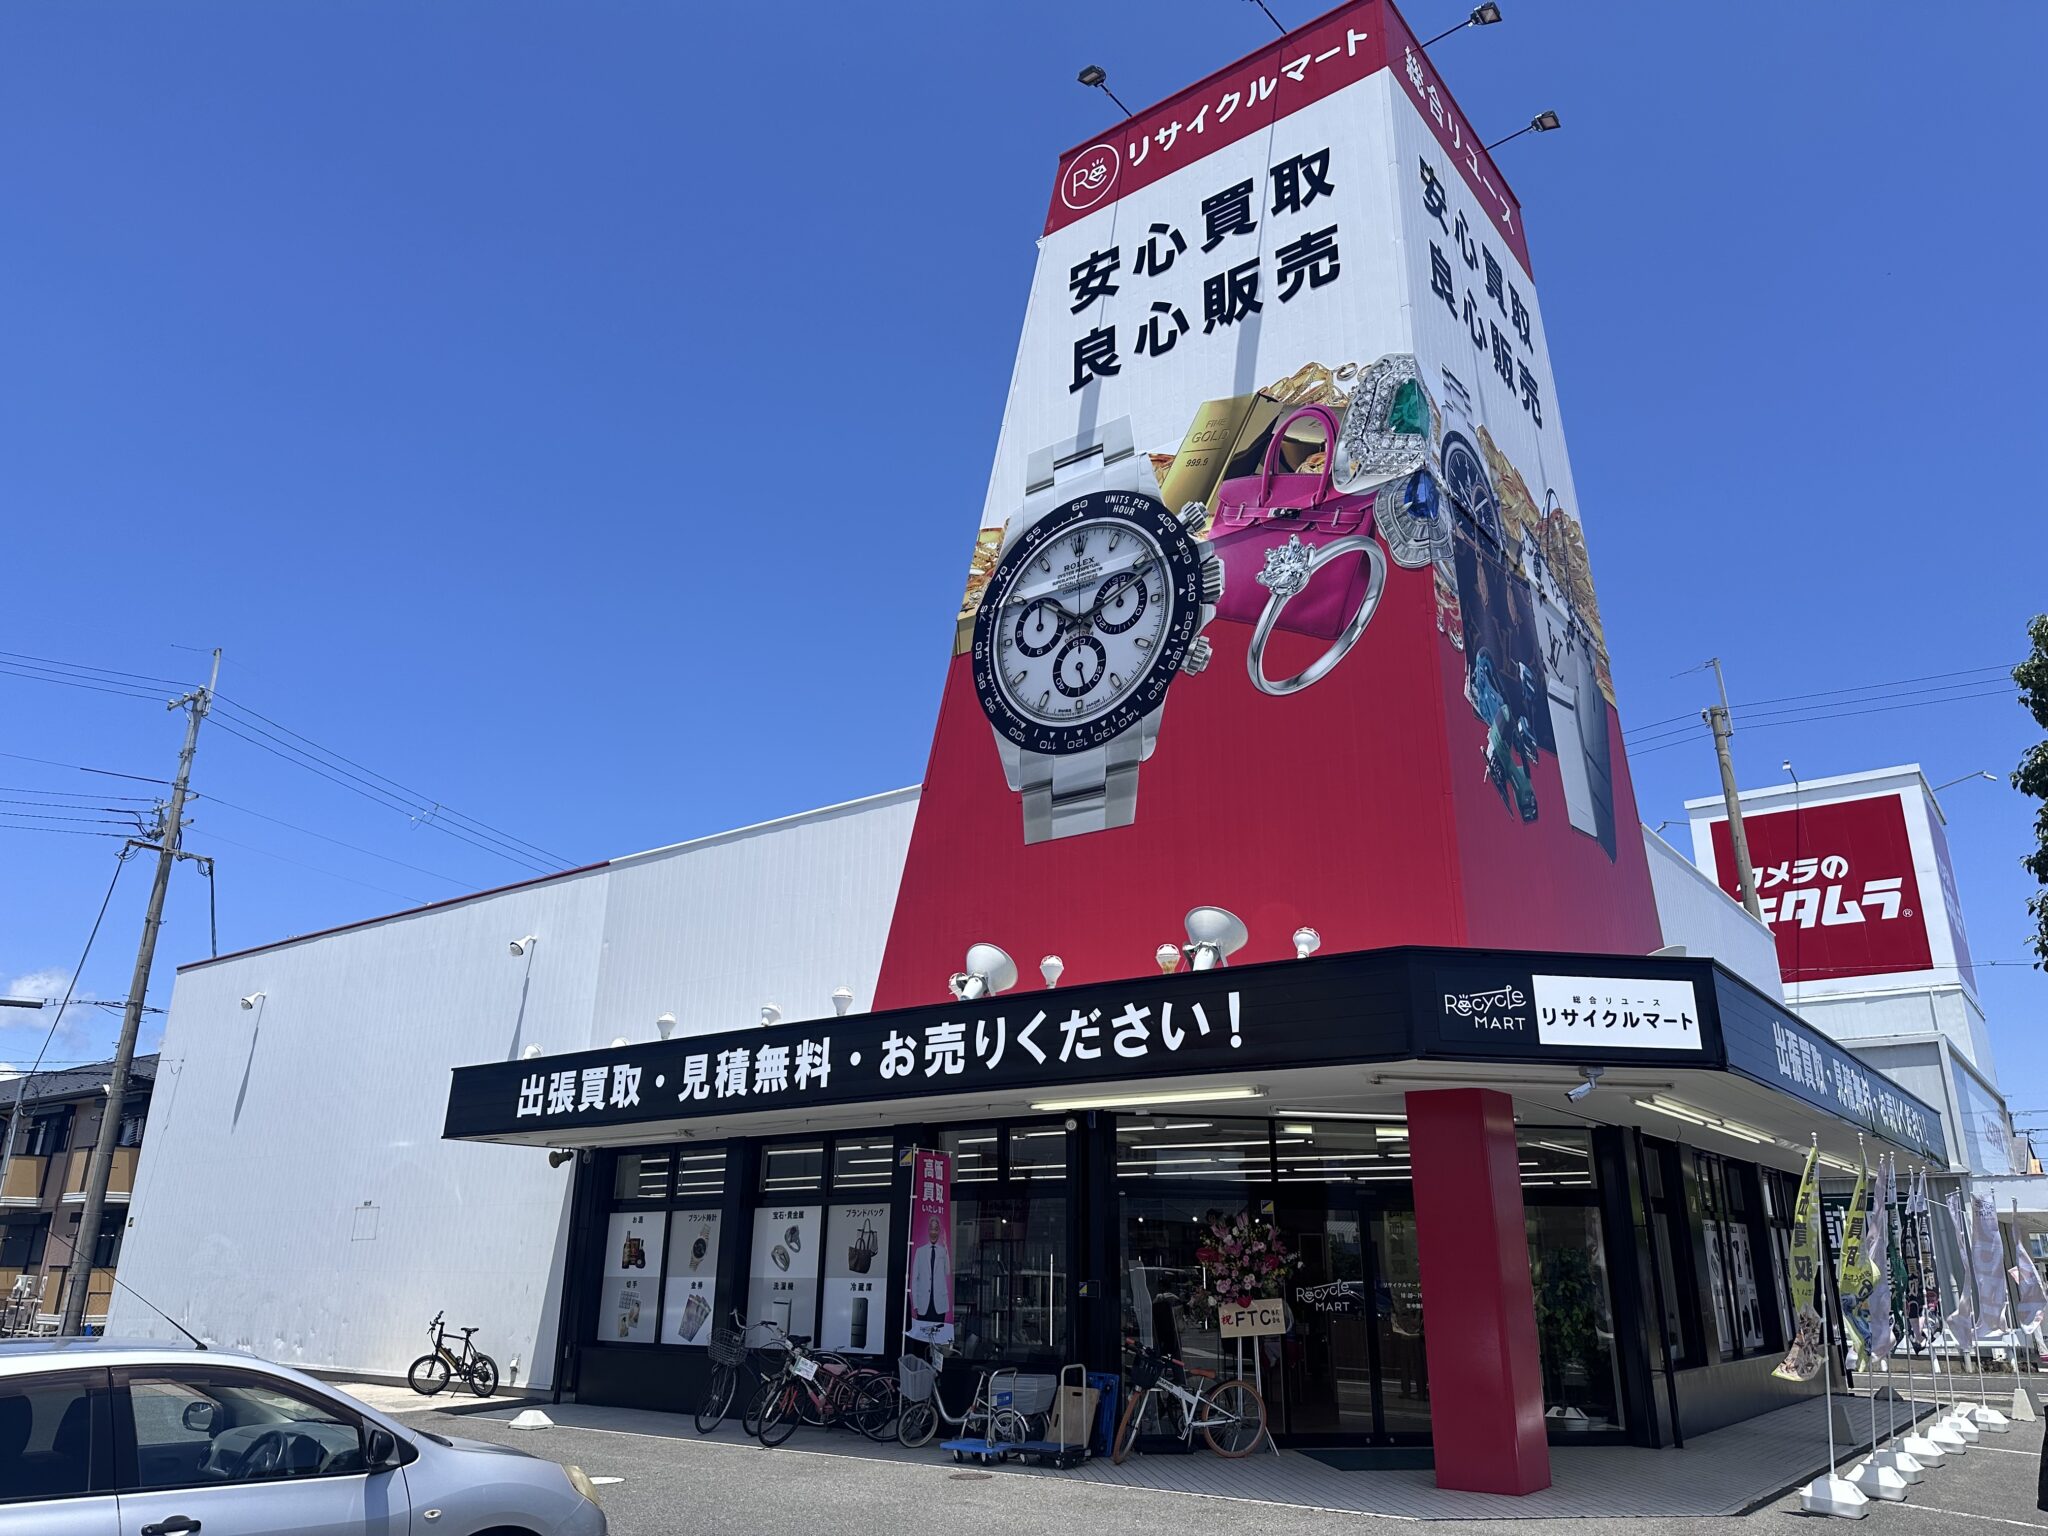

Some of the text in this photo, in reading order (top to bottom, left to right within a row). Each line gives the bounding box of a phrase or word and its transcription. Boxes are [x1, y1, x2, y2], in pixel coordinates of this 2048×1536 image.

[1128, 28, 1368, 167] リサイクルマート
[1404, 45, 1516, 235] 総合リユース
[1068, 147, 1336, 315] 安心買取
[1419, 153, 1534, 355] 安心買取
[1068, 223, 1341, 394] 良心販売
[1428, 238, 1542, 429] 良心販売
[1205, 417, 1227, 429] FINE
[1191, 428, 1230, 444] GOLD
[1185, 456, 1210, 468] 999.9
[1071, 499, 1089, 512] 60
[1105, 495, 1150, 511] UNITS PER
[1112, 505, 1136, 516] HOUR
[1156, 512, 1177, 533] 400
[1025, 526, 1042, 543] 65
[1176, 538, 1193, 565] 300
[1063, 555, 1095, 572] ROLEX
[996, 565, 1008, 582] 70
[1187, 572, 1196, 602] 240
[1135, 604, 1144, 616] 10
[1180, 610, 1195, 641] 200
[975, 641, 983, 660] 80
[1167, 645, 1185, 671] 180
[976, 672, 987, 690] 85
[1093, 666, 1104, 682] 20
[1055, 677, 1065, 690] 40
[1147, 677, 1167, 701] 160
[984, 697, 997, 714] 90
[1118, 708, 1140, 729] 140
[1008, 726, 1027, 743] 100
[1094, 726, 1117, 742] 130
[1039, 739, 1057, 750] 110
[1067, 738, 1089, 750] 120
[1444, 984, 1526, 1017] Recycle
[1572, 995, 1661, 1007] 総合リユース
[1475, 1016, 1526, 1031] MART
[1542, 1007, 1694, 1031] リサイクルマート
[923, 1159, 944, 1181] 高価
[846, 1208, 884, 1218] ブランドバッグ
[1296, 1278, 1351, 1303] Recycle
[1315, 1301, 1350, 1312] MART
[1235, 1309, 1271, 1328] FTC
